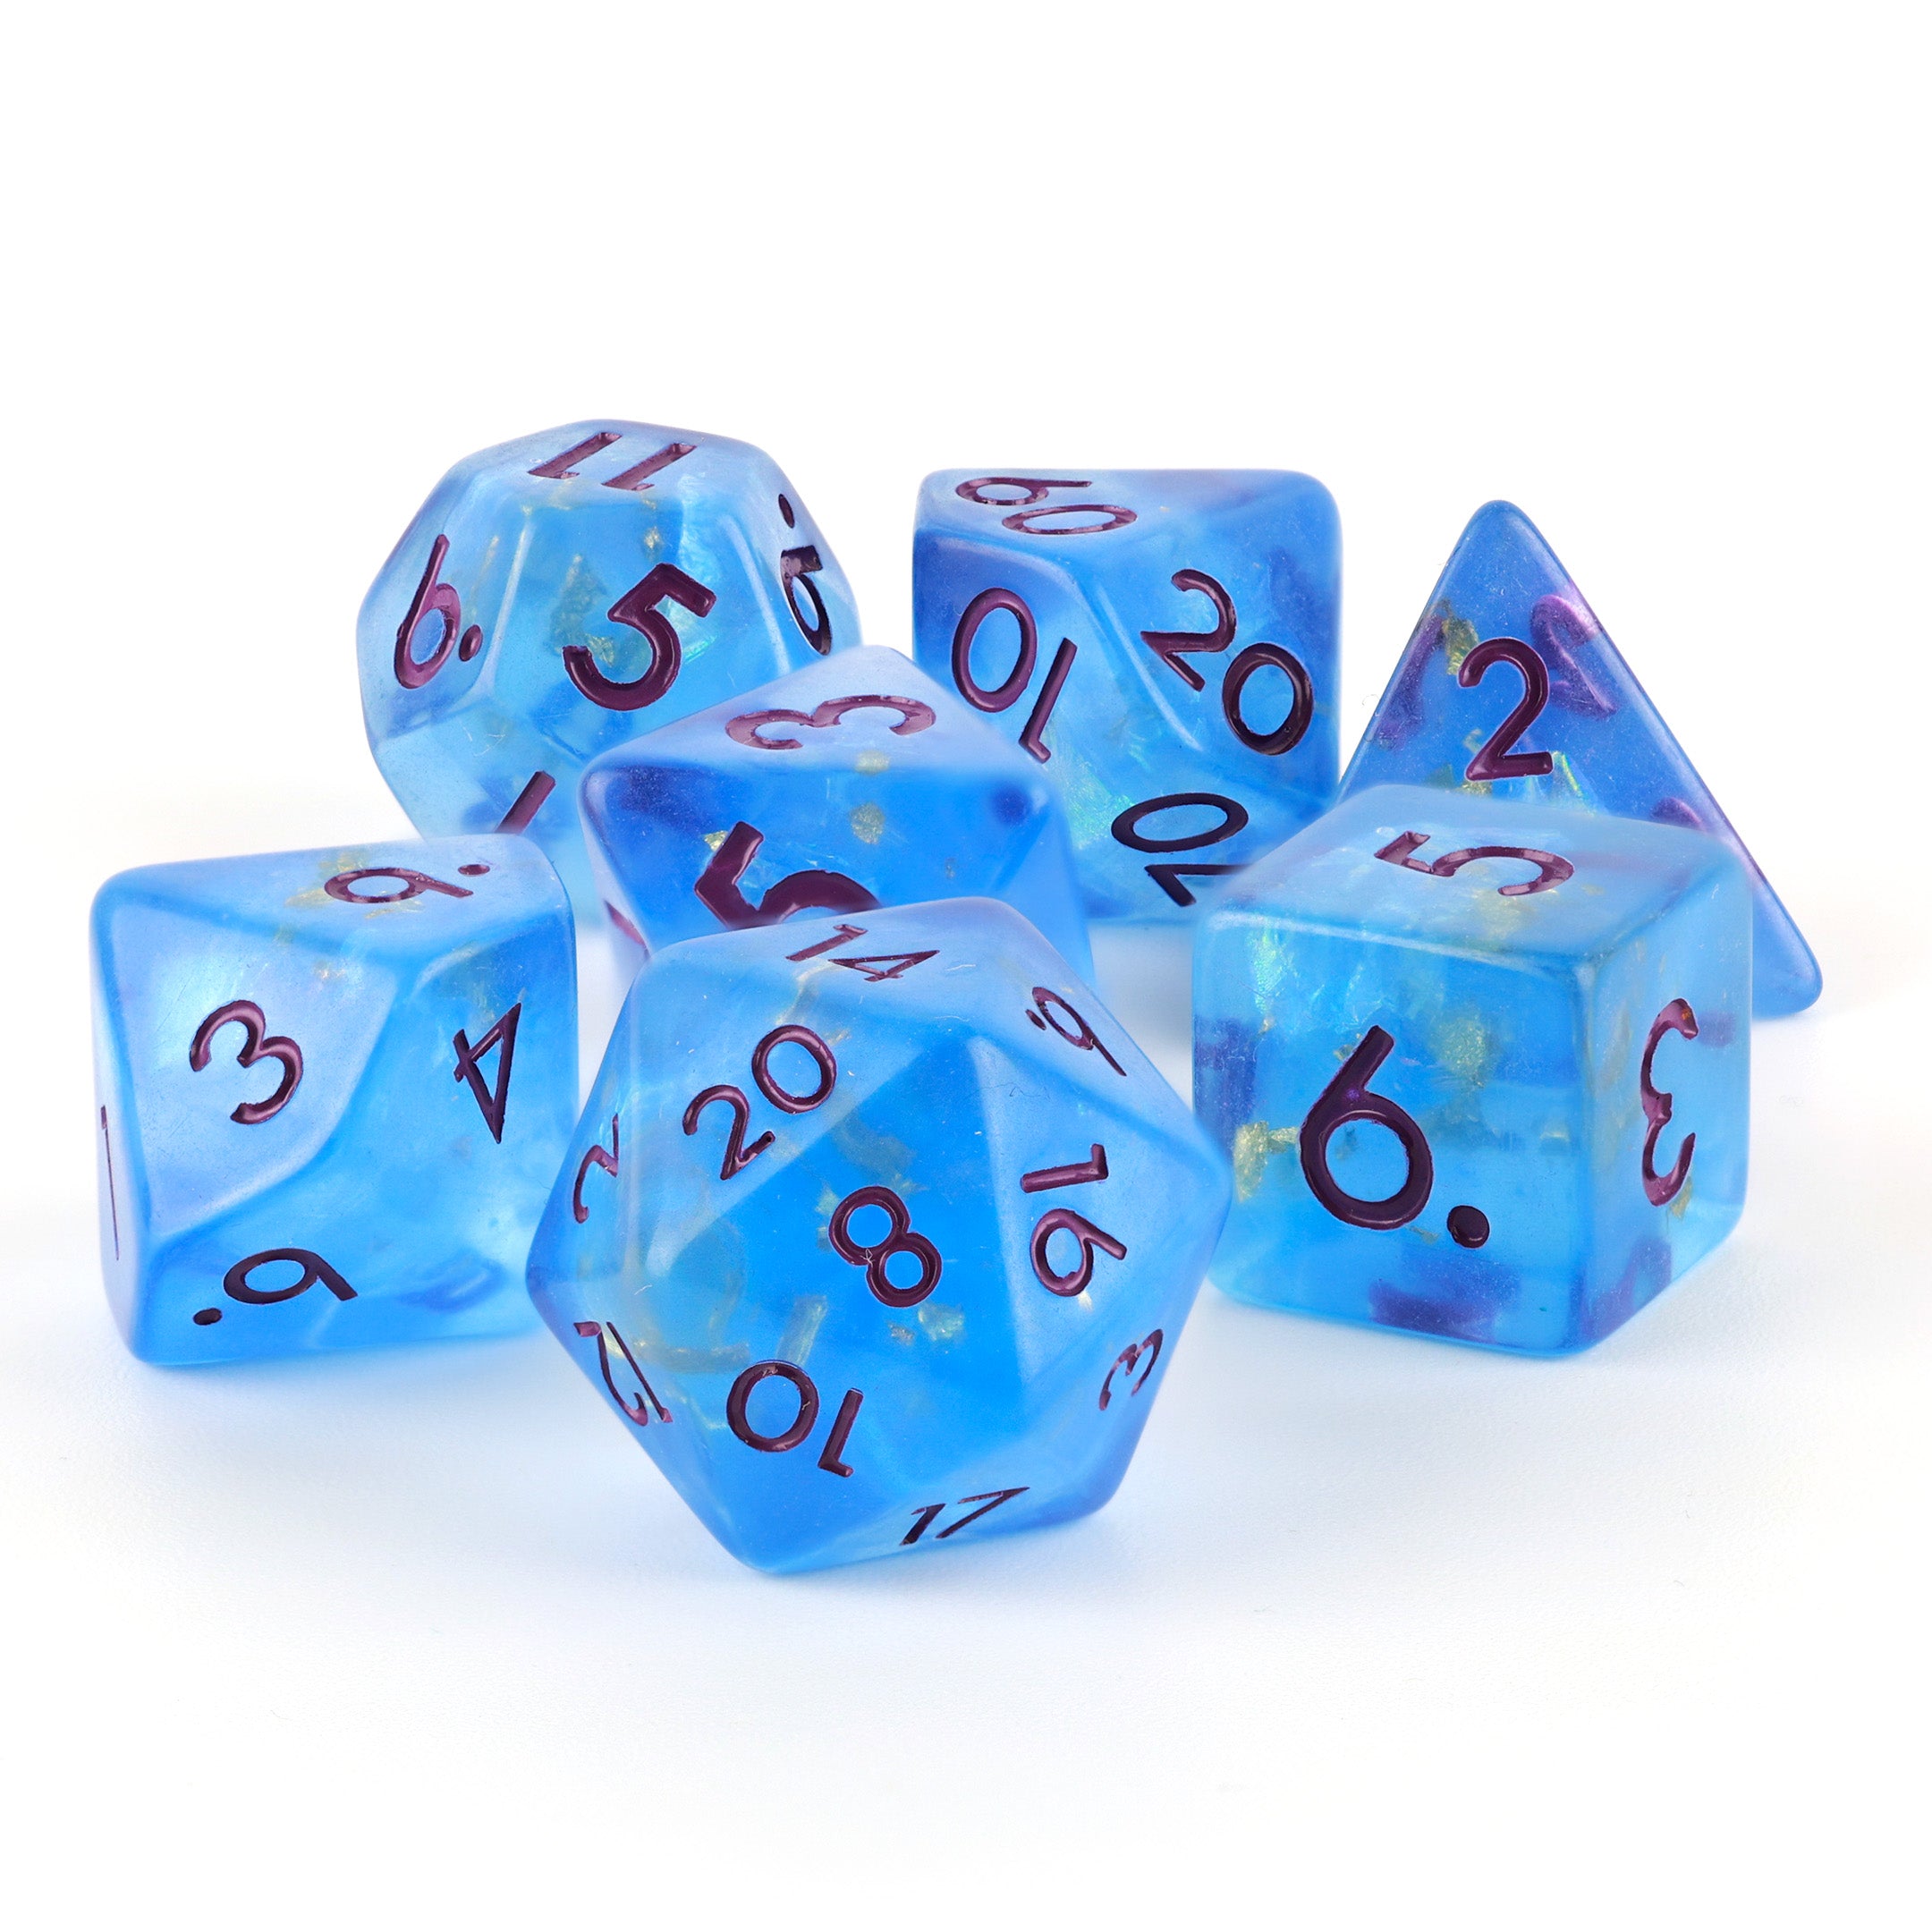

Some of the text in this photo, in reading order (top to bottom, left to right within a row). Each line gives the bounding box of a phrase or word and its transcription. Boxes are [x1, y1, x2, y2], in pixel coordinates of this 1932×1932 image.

[528, 431, 698, 491] 11
[955, 477, 1138, 535] 60
[563, 563, 716, 711] 5
[951, 587, 1078, 764] 10
[1140, 569, 1314, 756] 20
[724, 694, 936, 751] 3
[1458, 637, 1554, 781] 2
[1373, 830, 1575, 896] 5
[786, 923, 941, 982] 14
[189, 999, 304, 1125] 3
[453, 1003, 521, 1144] 4
[682, 1024, 837, 1180] 20
[1640, 997, 1699, 1207] 3
[829, 1186, 943, 1308] 8
[1020, 1143, 1127, 1297] 16
[573, 1320, 674, 1427] 12
[726, 1360, 864, 1478] 10
[1098, 1329, 1164, 1411] 3
[899, 1487, 1030, 1546] 17
